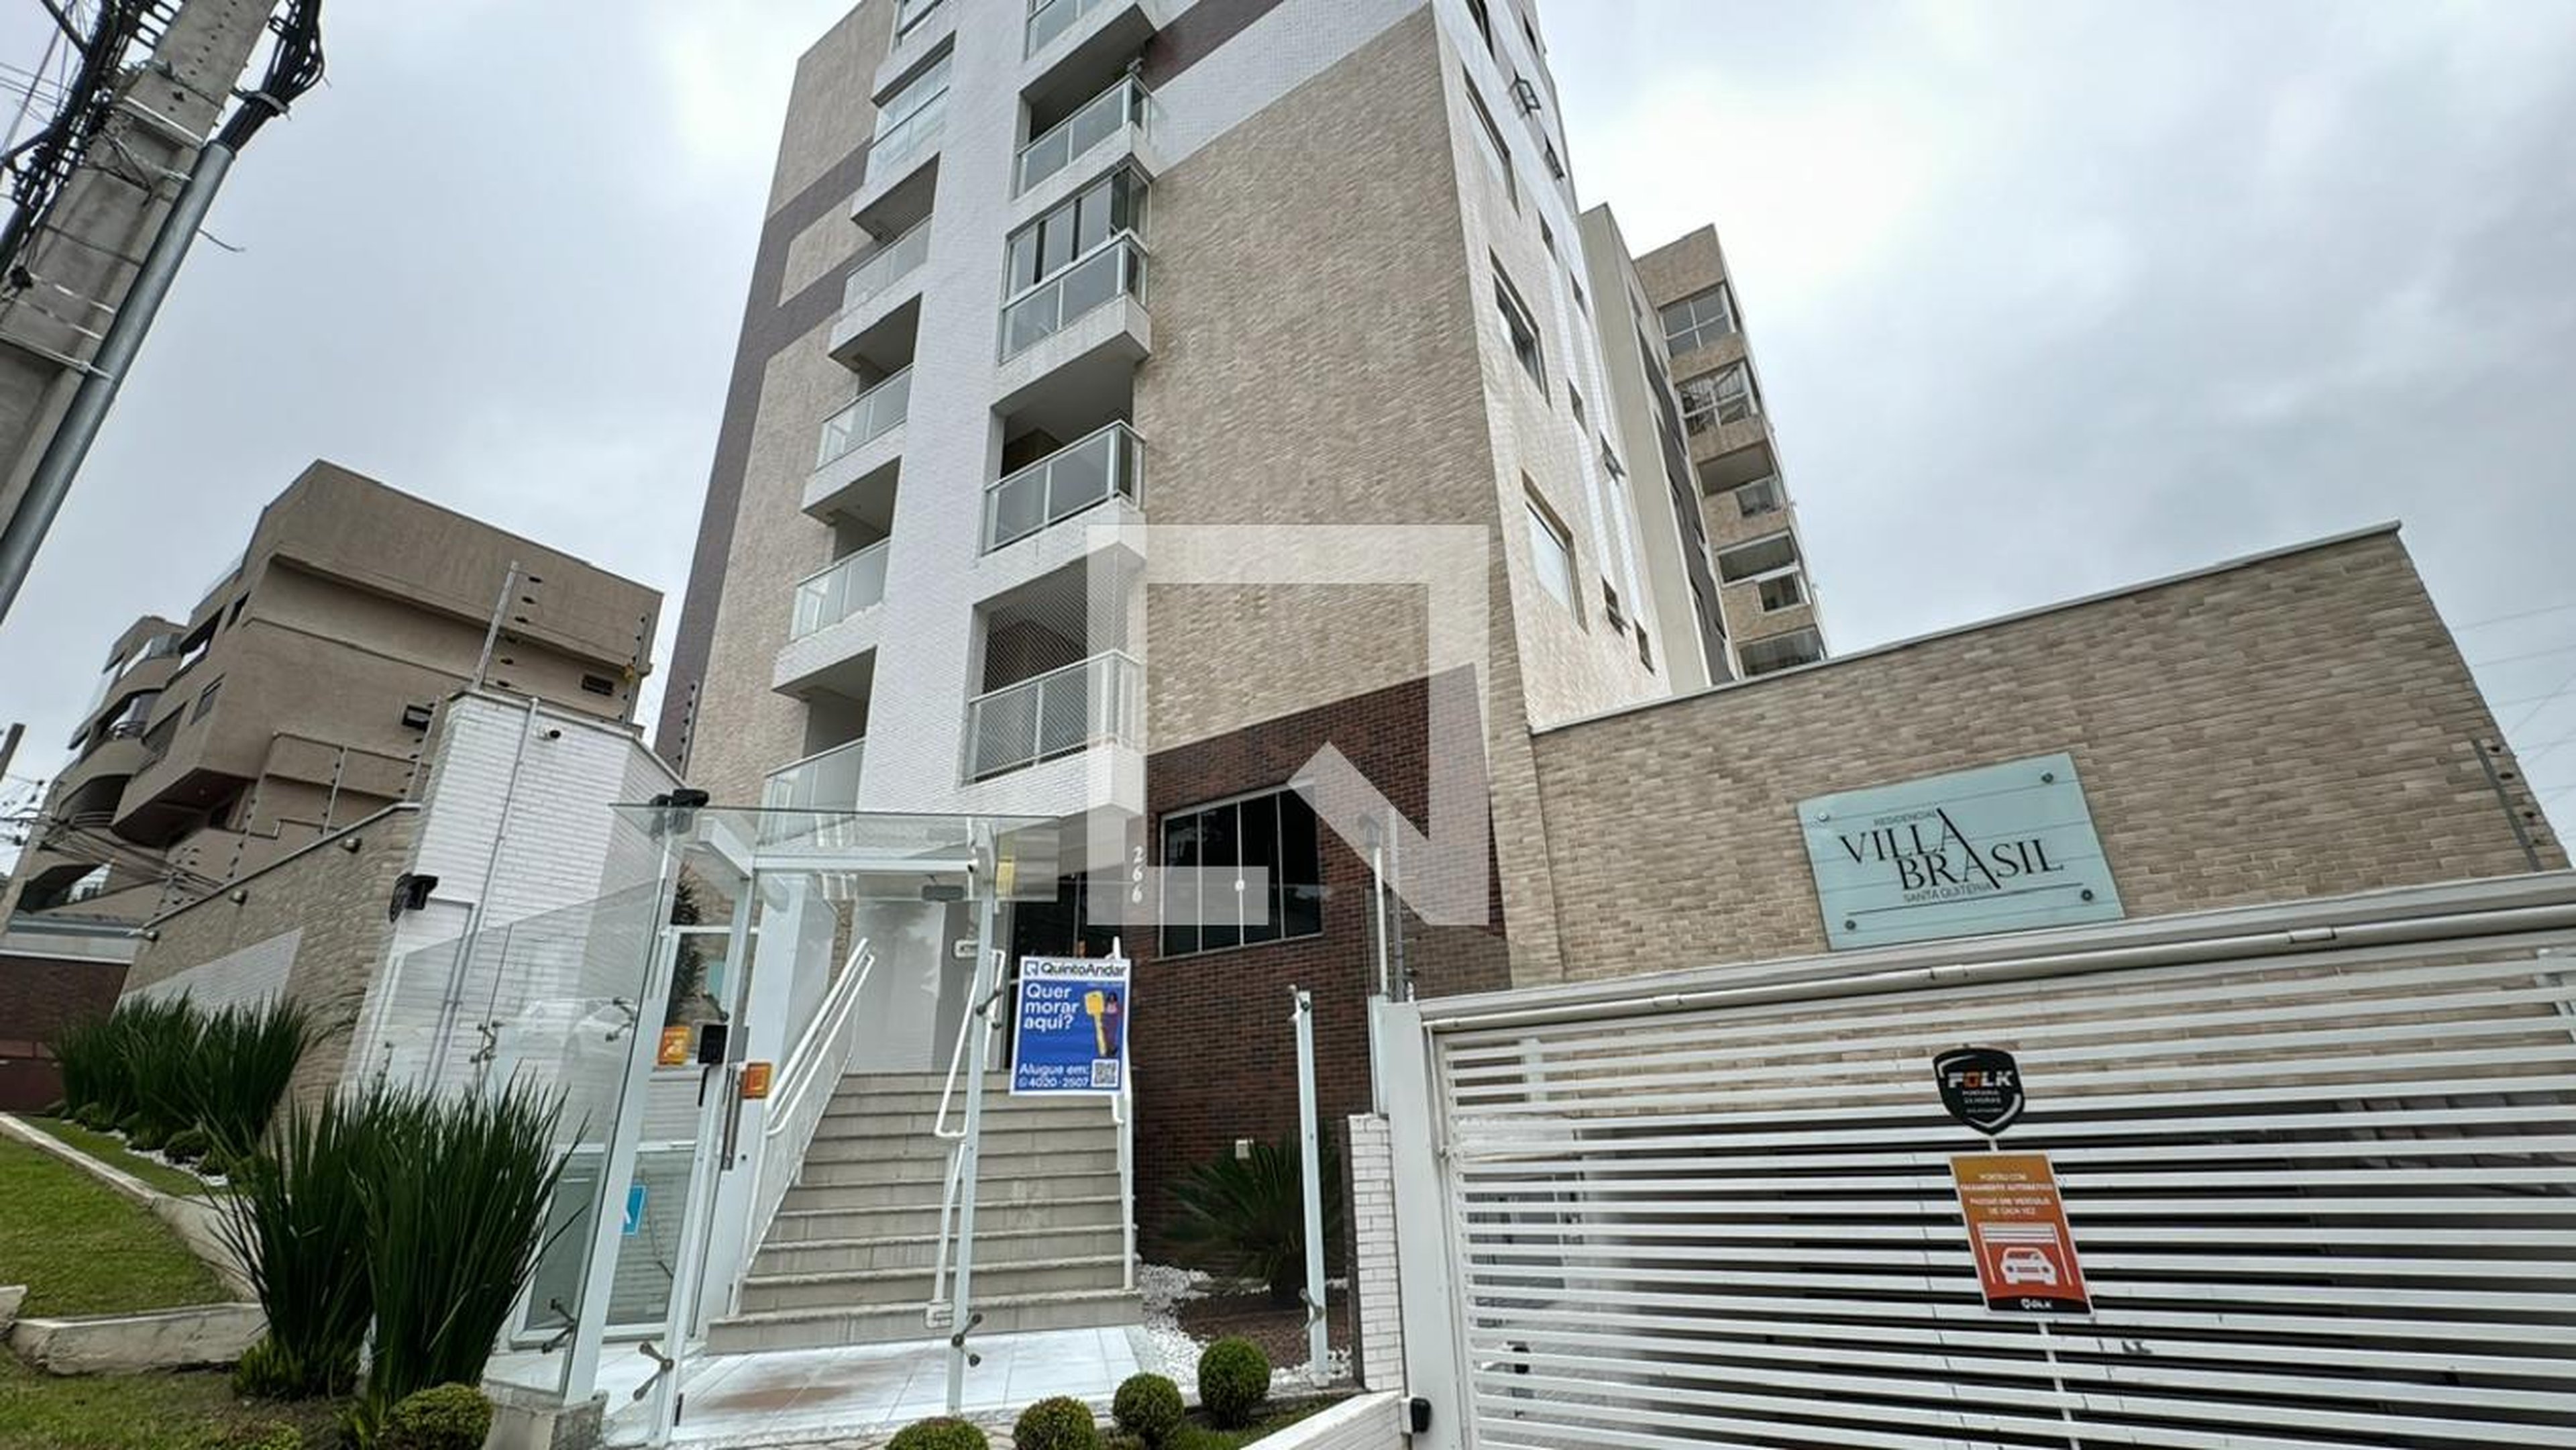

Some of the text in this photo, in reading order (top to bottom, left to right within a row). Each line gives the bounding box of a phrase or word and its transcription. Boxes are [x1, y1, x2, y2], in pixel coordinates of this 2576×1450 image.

[1839, 807, 1974, 864] VILLA
[1896, 839, 2064, 890] BRASIL
[1132, 845, 1144, 904] 266
[1902, 888, 1940, 903] SANTA
[1040, 962, 1127, 976] QuintoAndar
[1026, 982, 1073, 999] Quer
[1025, 1001, 1081, 1015] morar
[1023, 1013, 1074, 1033] aqui?
[1019, 1063, 1065, 1078] Alugue
[1947, 1070, 2013, 1088] FOLK
